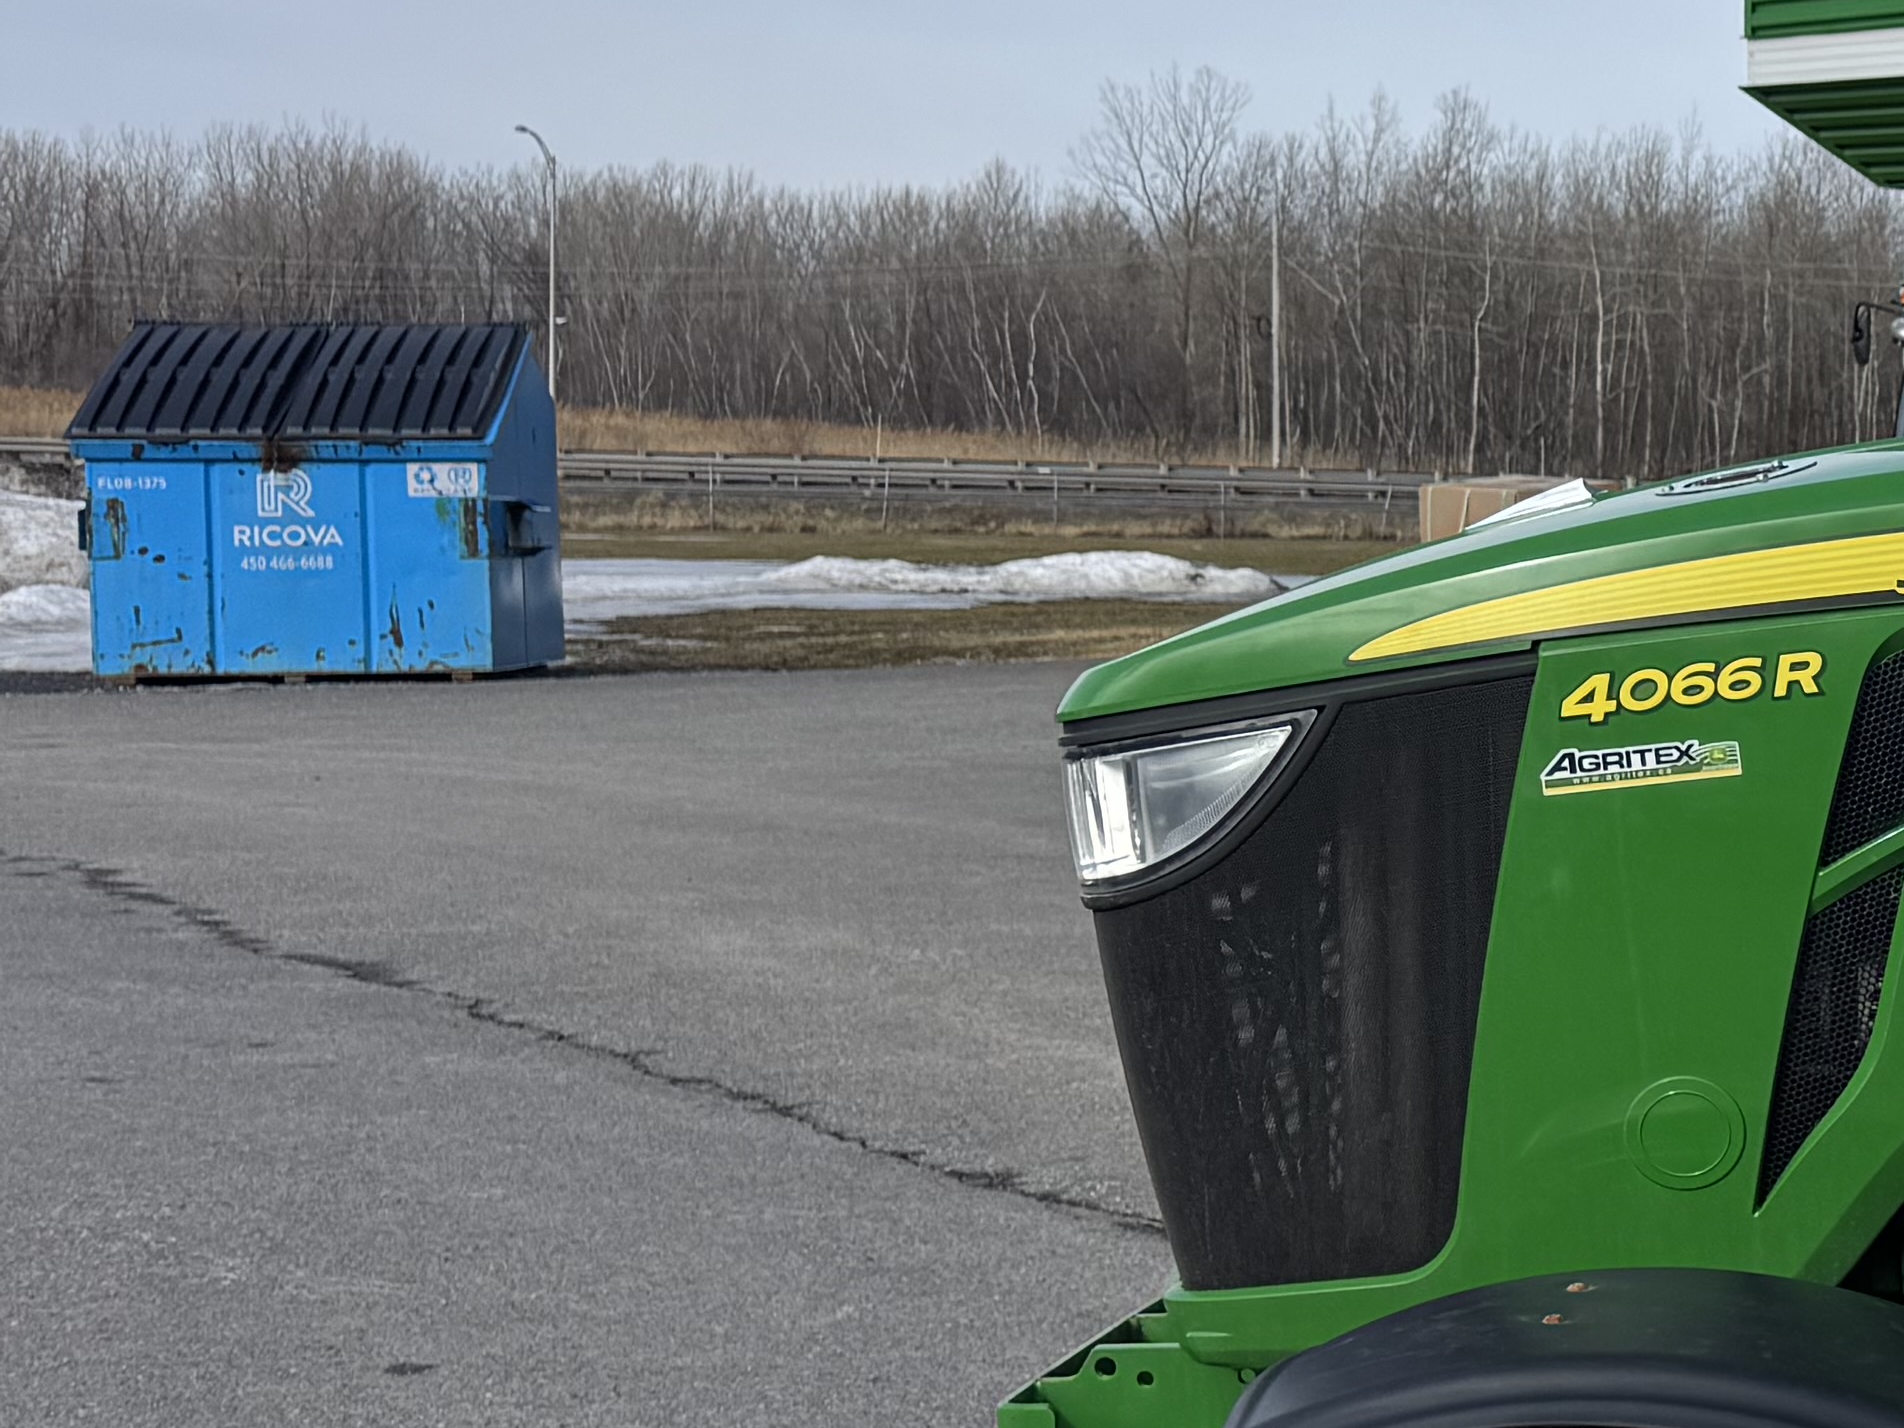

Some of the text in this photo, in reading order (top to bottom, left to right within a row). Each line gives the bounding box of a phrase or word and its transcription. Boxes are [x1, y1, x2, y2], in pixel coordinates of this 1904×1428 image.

[233, 525, 343, 547] RICOVA
[241, 555, 266, 571] 450
[1545, 743, 1697, 777] AGRITEX
